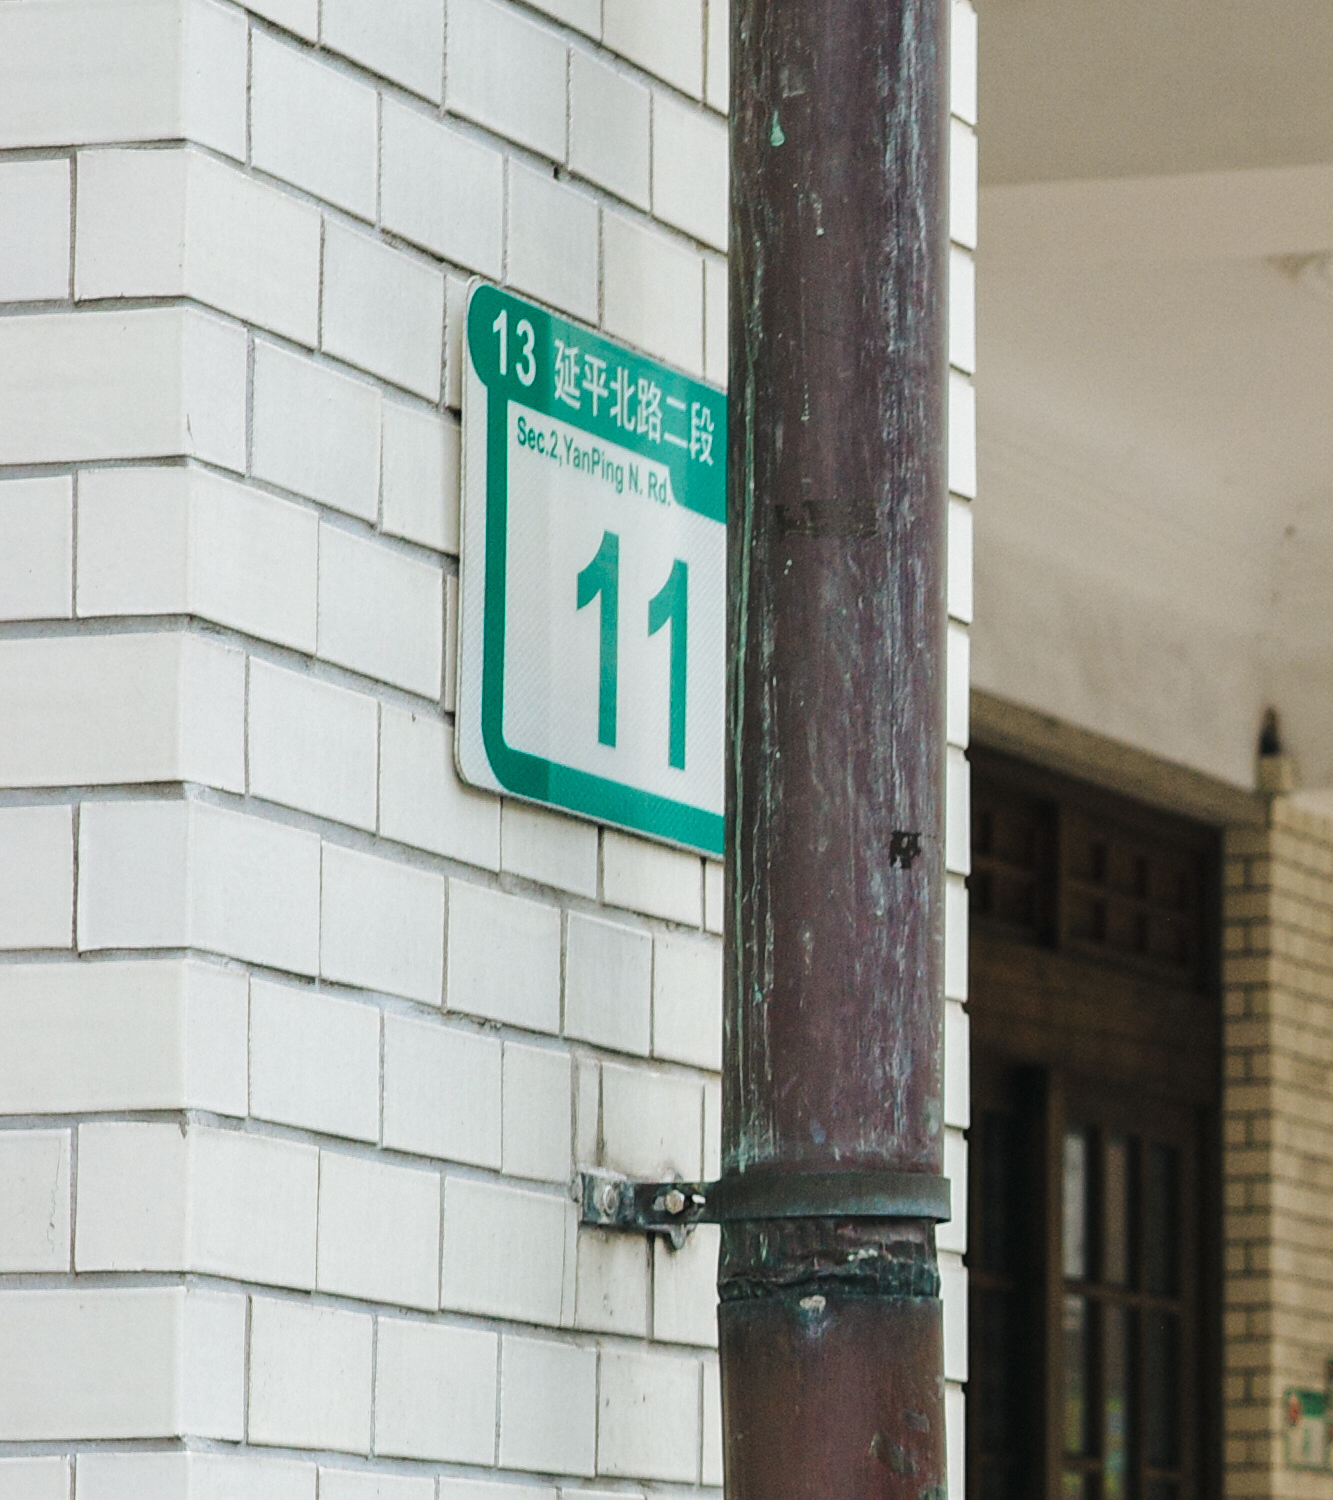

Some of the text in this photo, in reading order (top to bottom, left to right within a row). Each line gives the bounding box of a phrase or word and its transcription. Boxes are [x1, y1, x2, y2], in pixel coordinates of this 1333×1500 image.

[491, 309, 537, 387] 13
[553, 338, 715, 466] 延平北路二段
[629, 463, 643, 495] N.
[648, 470, 672, 507] Rd.
[575, 529, 689, 771] 11
